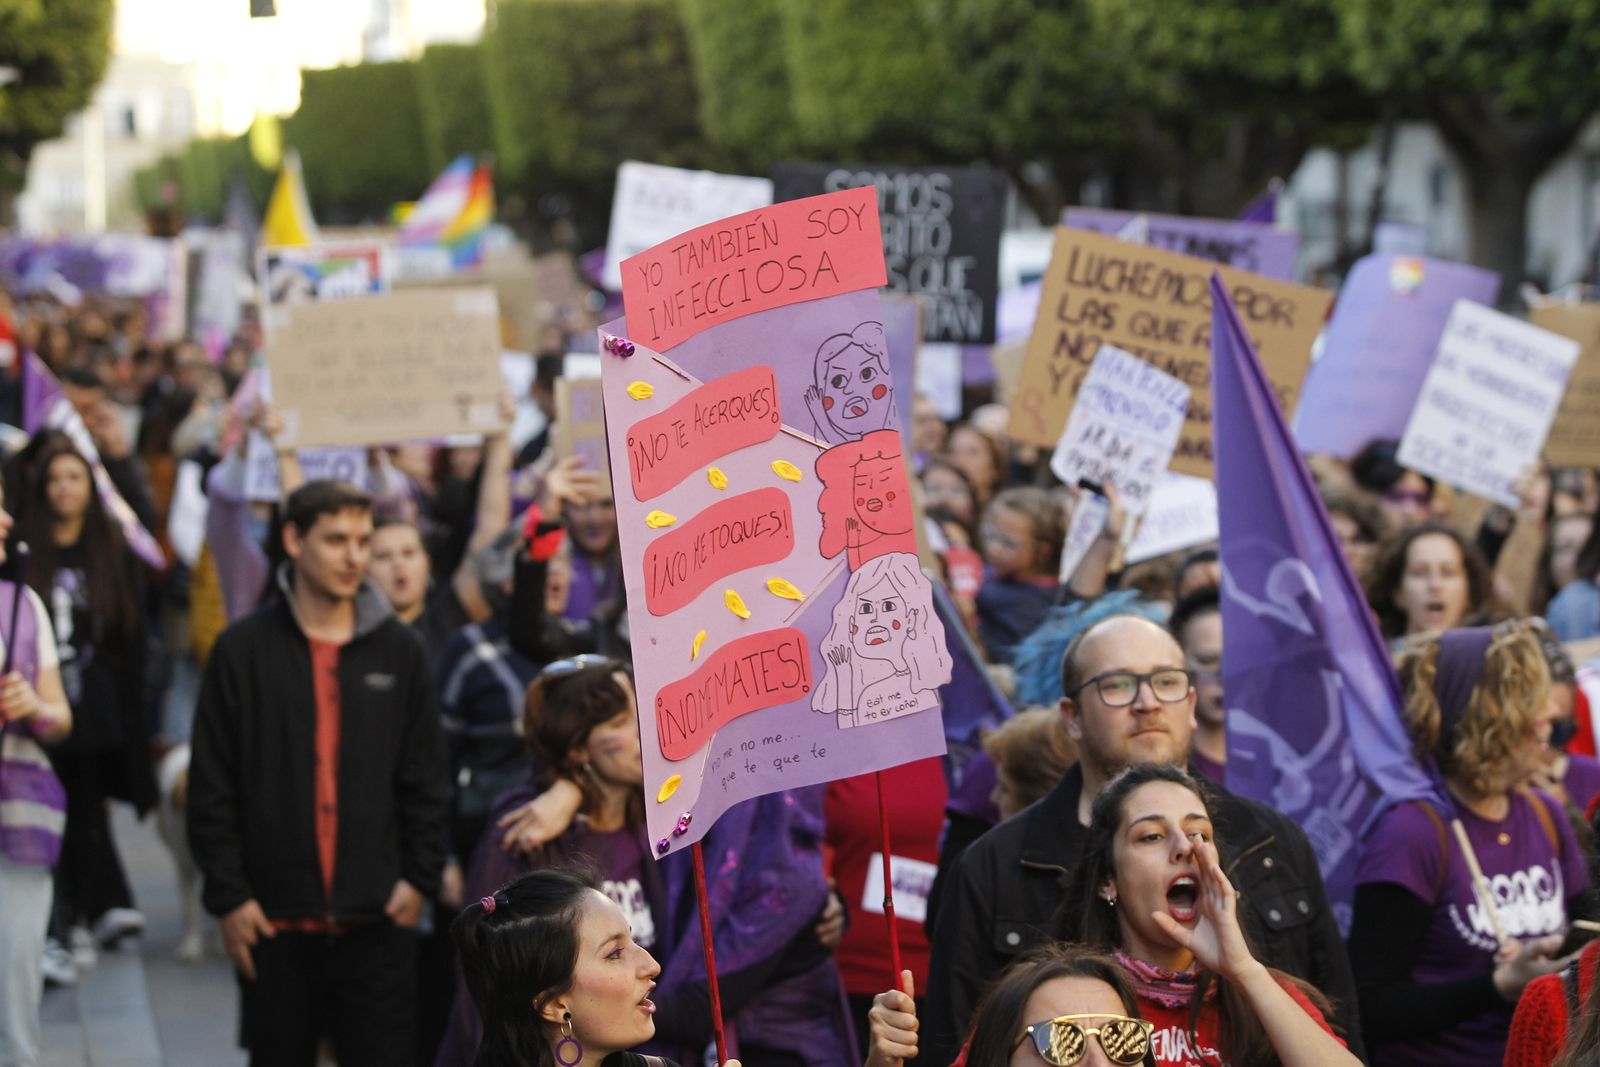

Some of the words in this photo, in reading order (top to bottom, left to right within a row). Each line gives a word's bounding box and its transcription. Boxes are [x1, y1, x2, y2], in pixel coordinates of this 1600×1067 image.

[639, 262, 663, 293] YO
[672, 214, 779, 276] TAMBIÉN
[807, 203, 866, 239] SOY
[648, 250, 840, 341] INFECCIOSA
[1057, 293, 1118, 330] LAS
[1128, 311, 1185, 345] QUE
[672, 420, 689, 448] TE
[694, 373, 780, 436] ACERQUES!
[709, 509, 790, 555] TOQUES!
[864, 709, 877, 721] to
[887, 691, 902, 701] me
[711, 757, 721, 773] no
[722, 747, 734, 760] me
[740, 740, 756, 753] no
[721, 771, 736, 793] que
[744, 758, 757, 774] te
[773, 753, 801, 773] que
[811, 743, 827, 758] te
